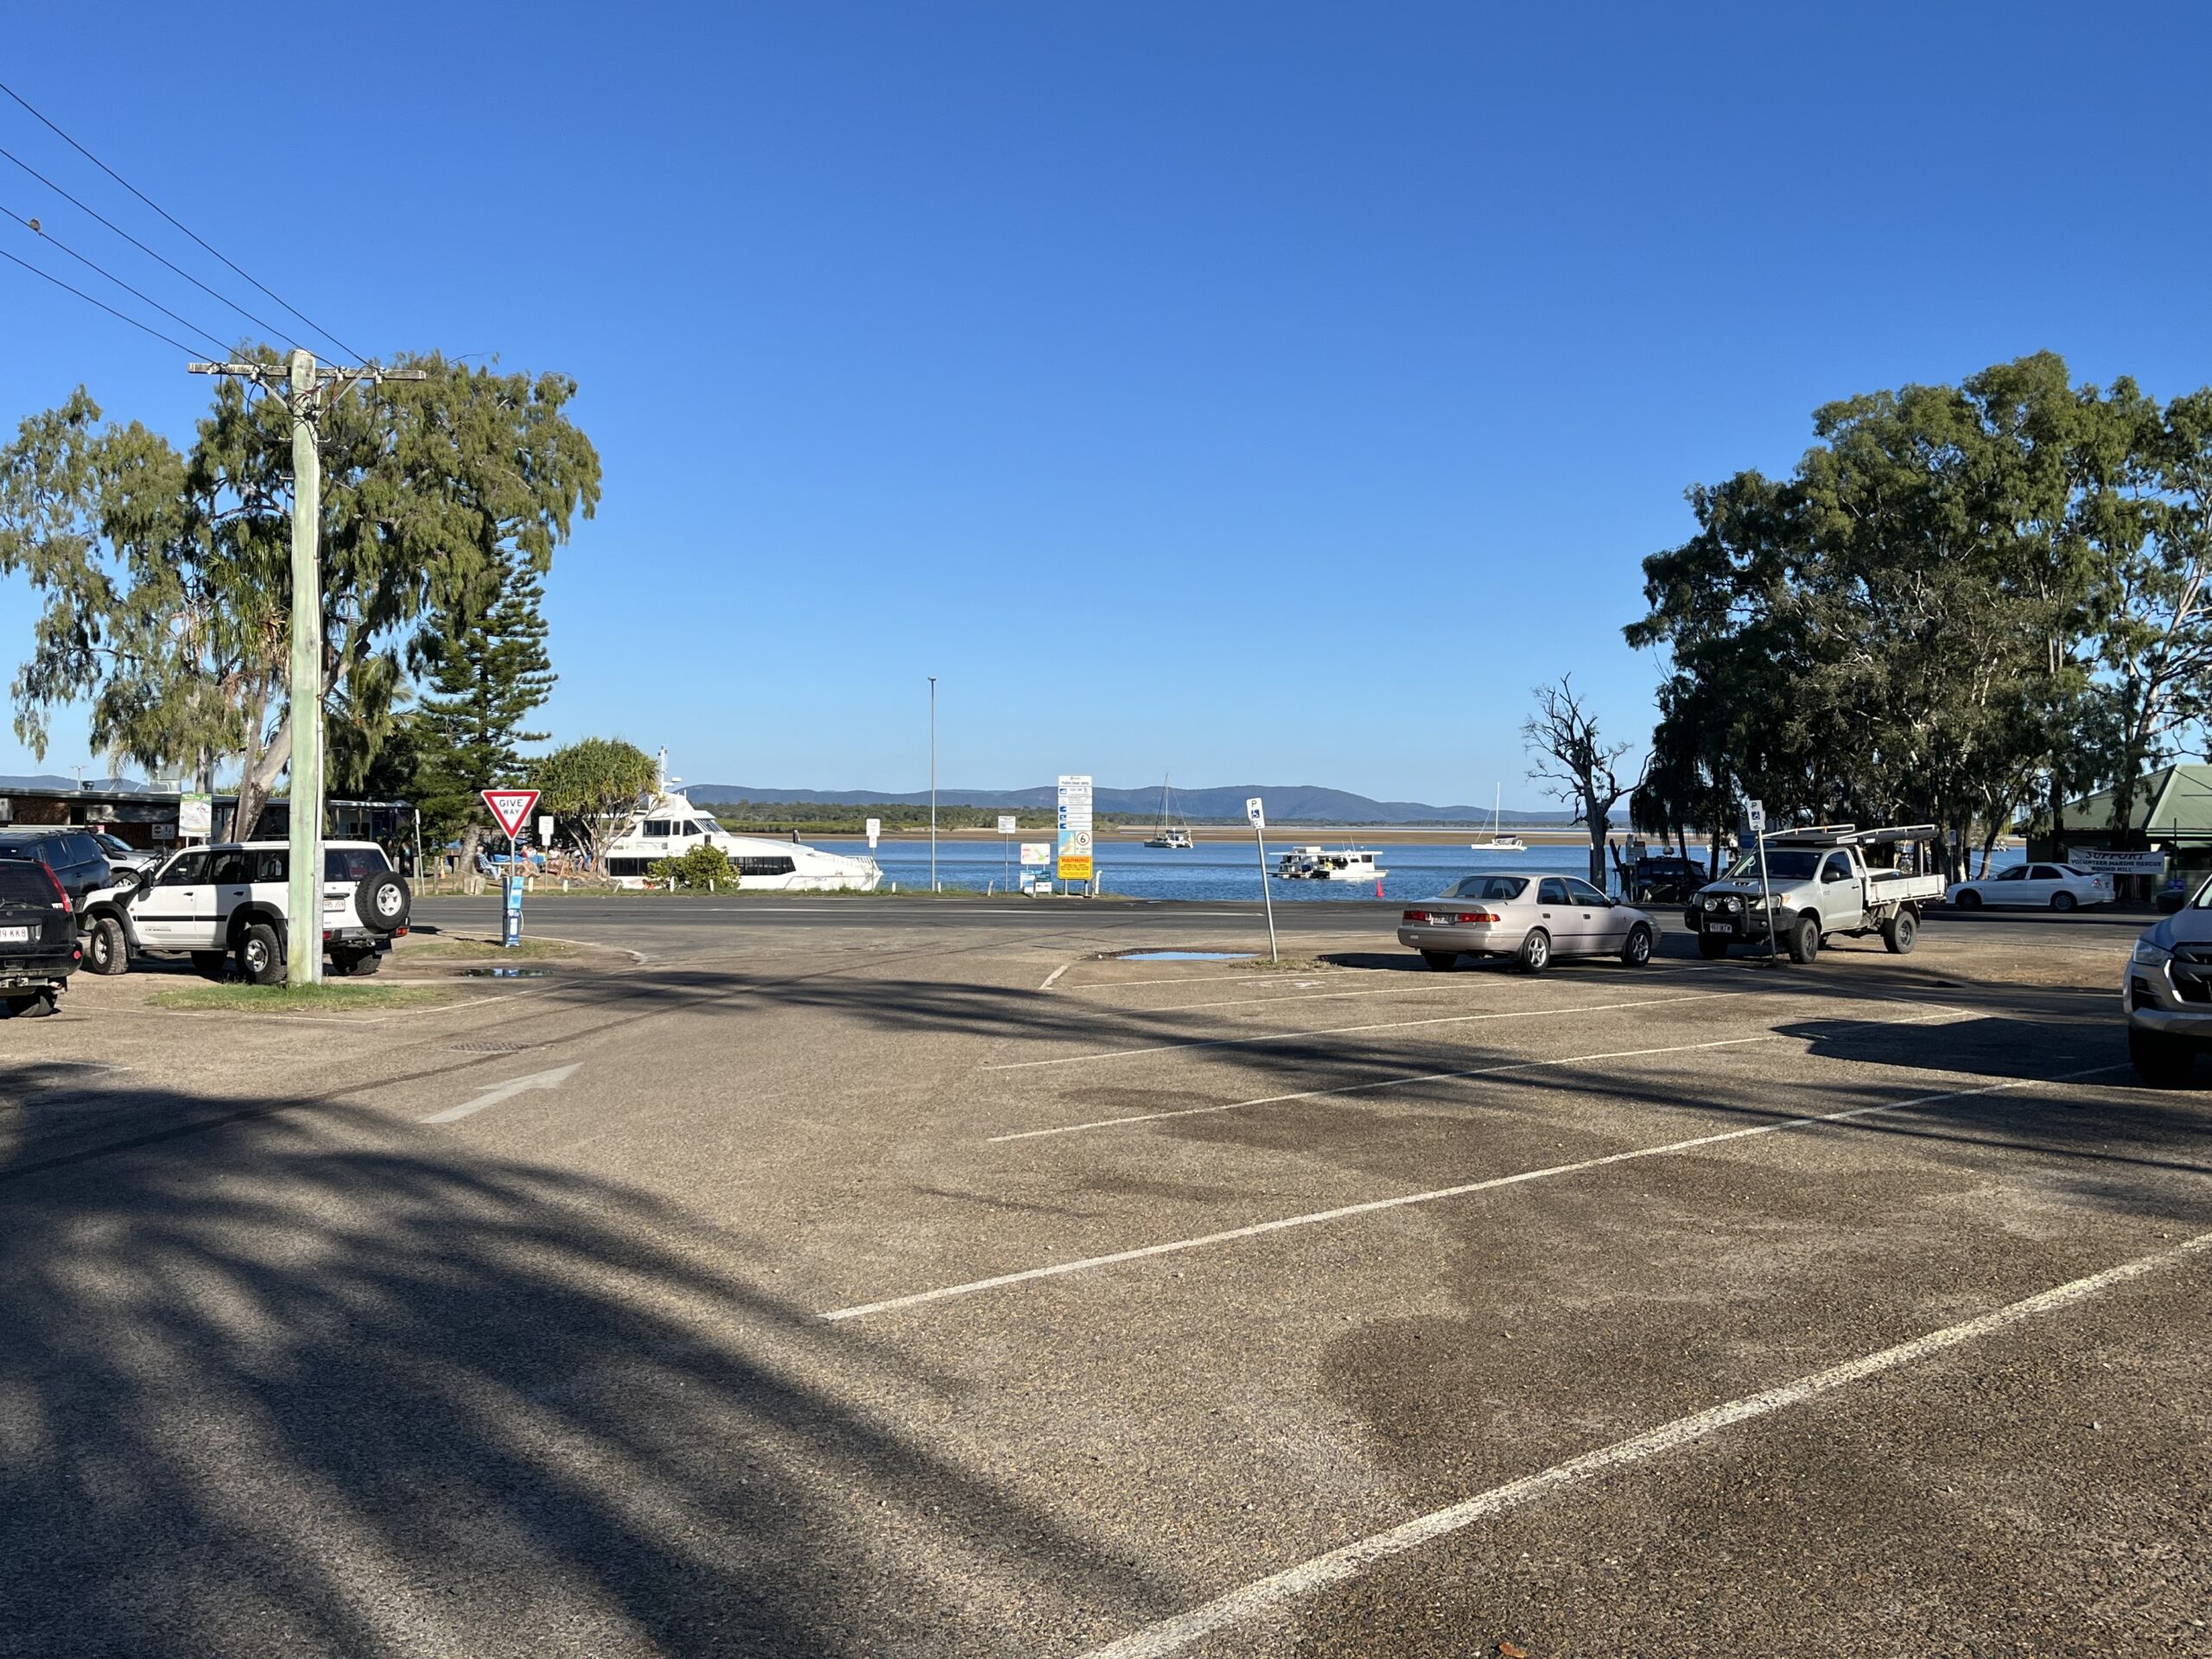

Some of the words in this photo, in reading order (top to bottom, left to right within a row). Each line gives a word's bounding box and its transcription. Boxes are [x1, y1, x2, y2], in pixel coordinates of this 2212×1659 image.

[1080, 835, 1086, 843] 6
[2086, 851, 2144, 860] SUPPORT
[10, 928, 26, 938] KK8
